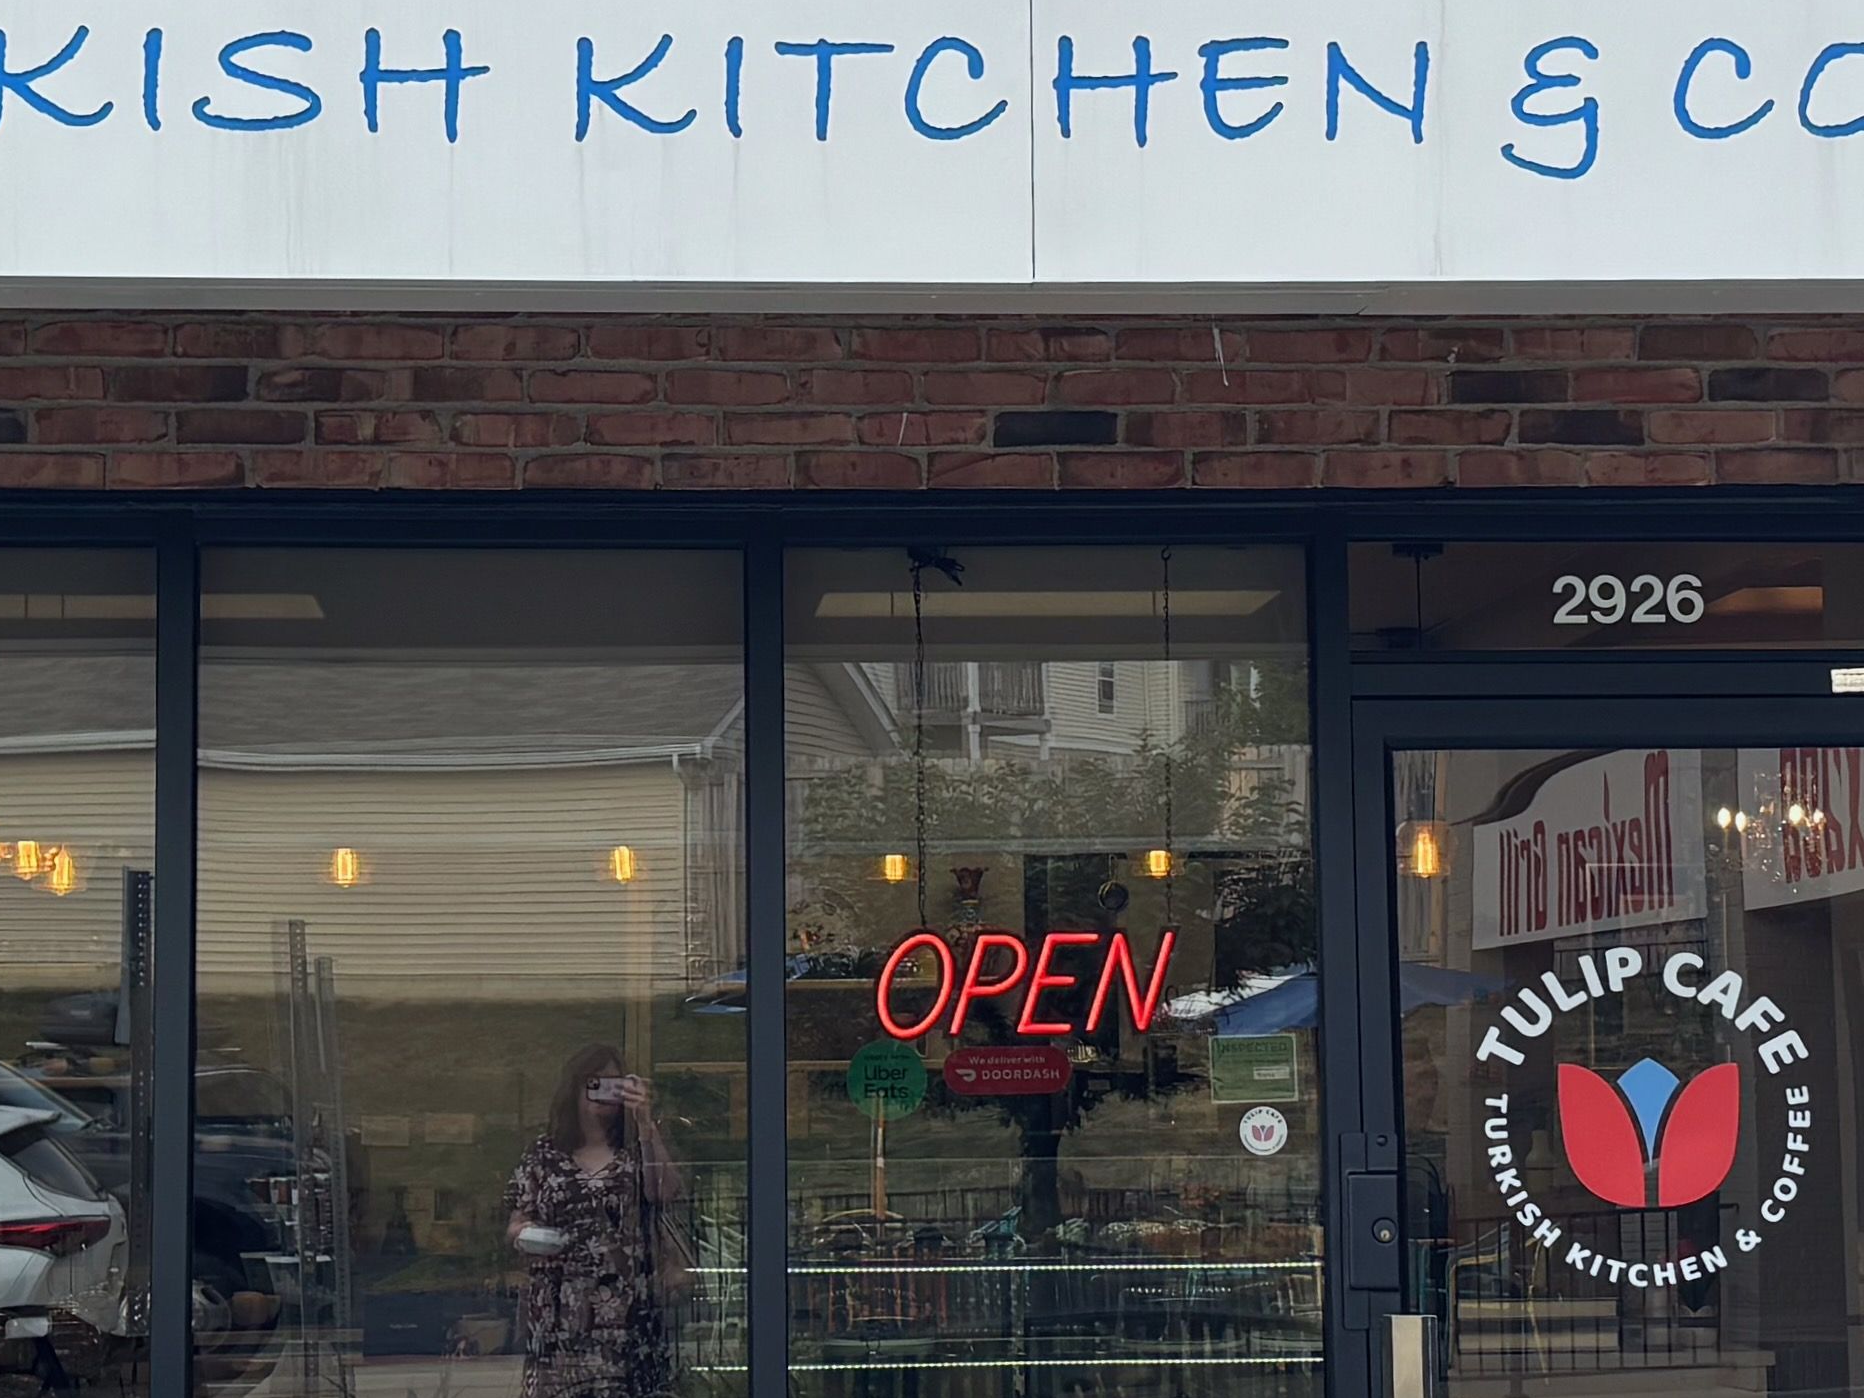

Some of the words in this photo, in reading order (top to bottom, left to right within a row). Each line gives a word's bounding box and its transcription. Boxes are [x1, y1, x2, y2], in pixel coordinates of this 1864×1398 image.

[575, 32, 1430, 149] KITCHEN
[1501, 35, 1599, 180] &
[1552, 574, 1705, 625] 2926
[875, 930, 1175, 1039] OPEN
[1476, 947, 1643, 1066] TULIP
[1663, 952, 1810, 1075] CAFE
[864, 1065, 908, 1081] Uber
[969, 1056, 985, 1065] We
[988, 1056, 1021, 1065] deliver
[1023, 1055, 1046, 1064] with
[981, 1069, 1061, 1081] DOORDASH
[863, 1083, 909, 1099] Eats
[1484, 1093, 1562, 1248] TURKISH
[1564, 1242, 1729, 1288] KITCHEN
[1735, 1228, 1763, 1253] &
[1760, 1085, 1812, 1224] COFFEE
